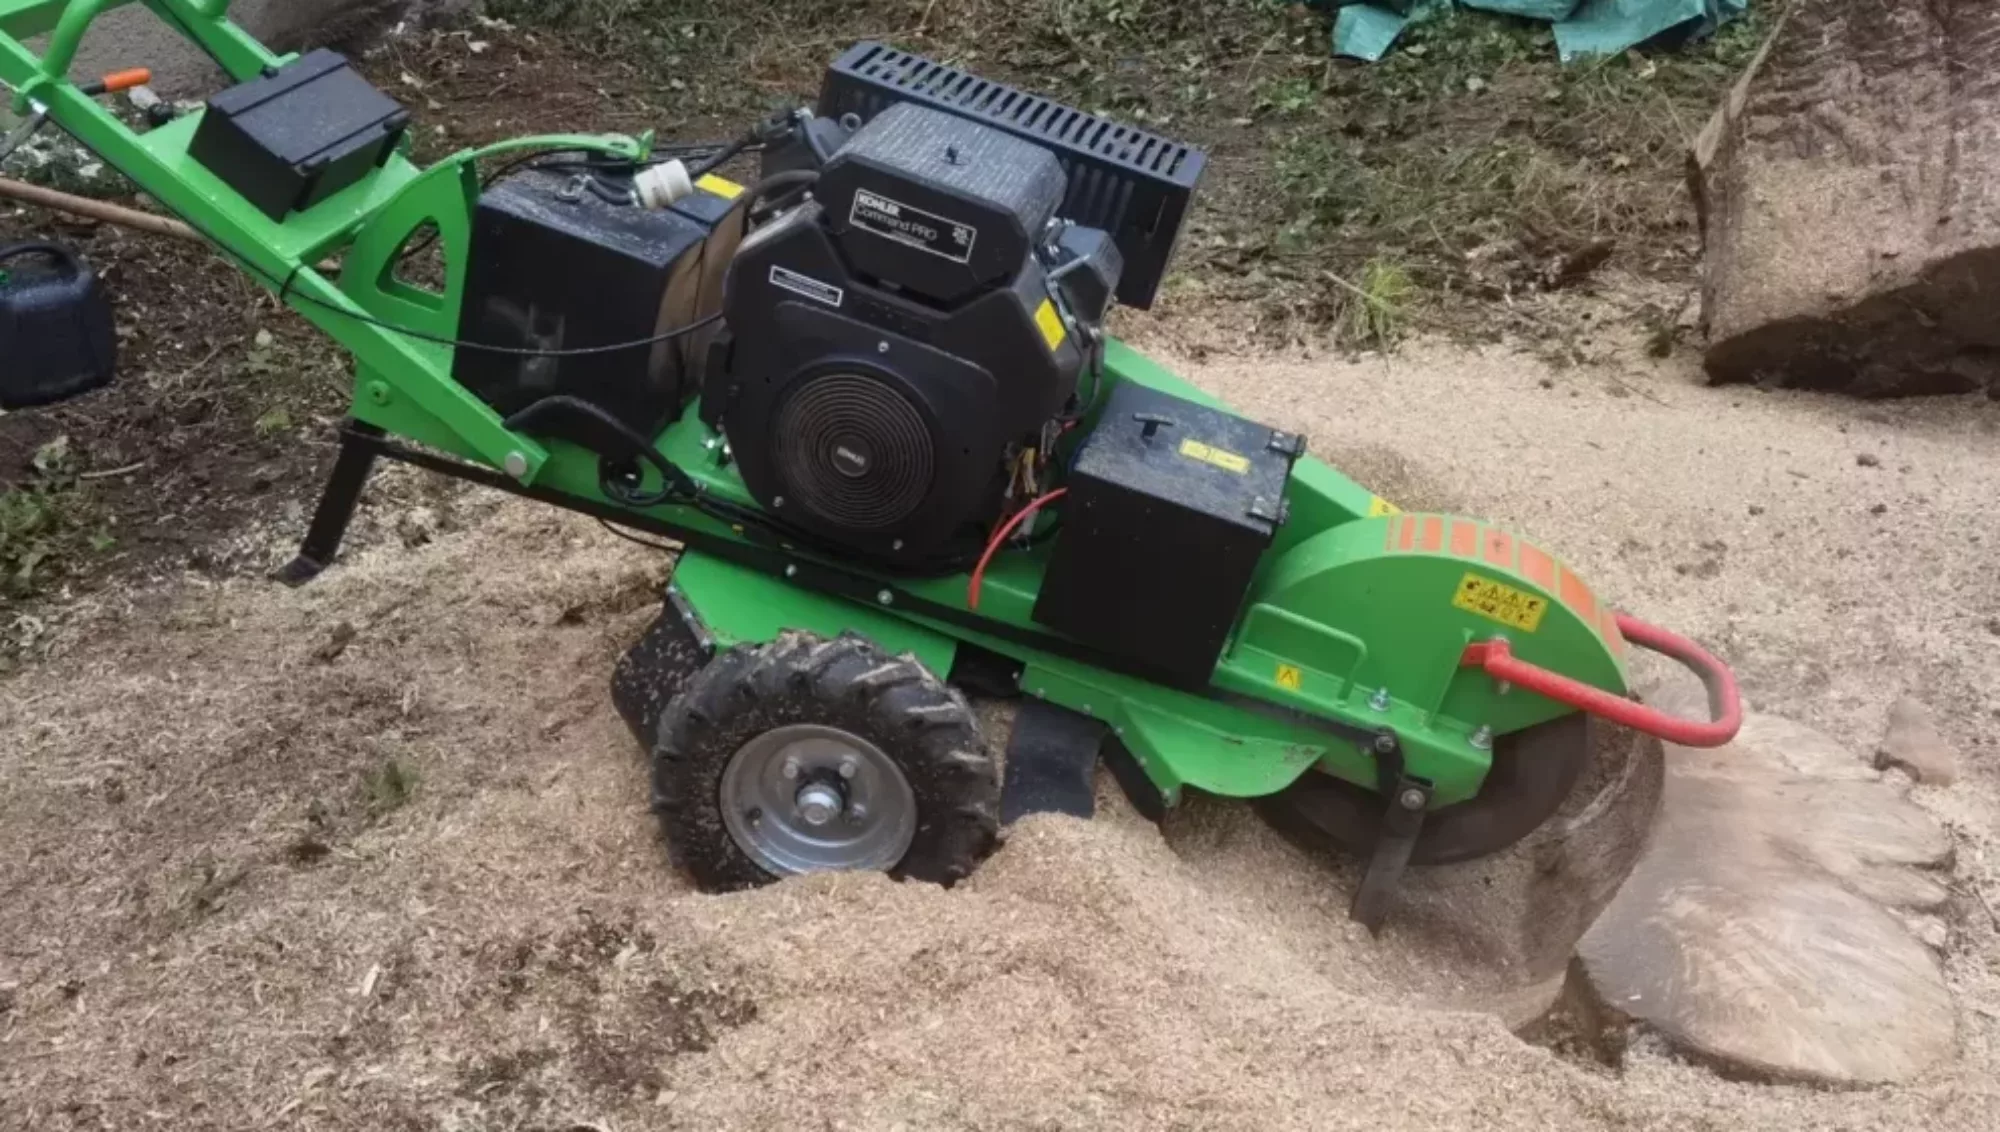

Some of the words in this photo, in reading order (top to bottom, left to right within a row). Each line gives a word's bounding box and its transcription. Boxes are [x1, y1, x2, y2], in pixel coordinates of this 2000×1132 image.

[858, 193, 900, 217] KOHLER
[857, 204, 911, 231] Command
[911, 222, 938, 241] PRO
